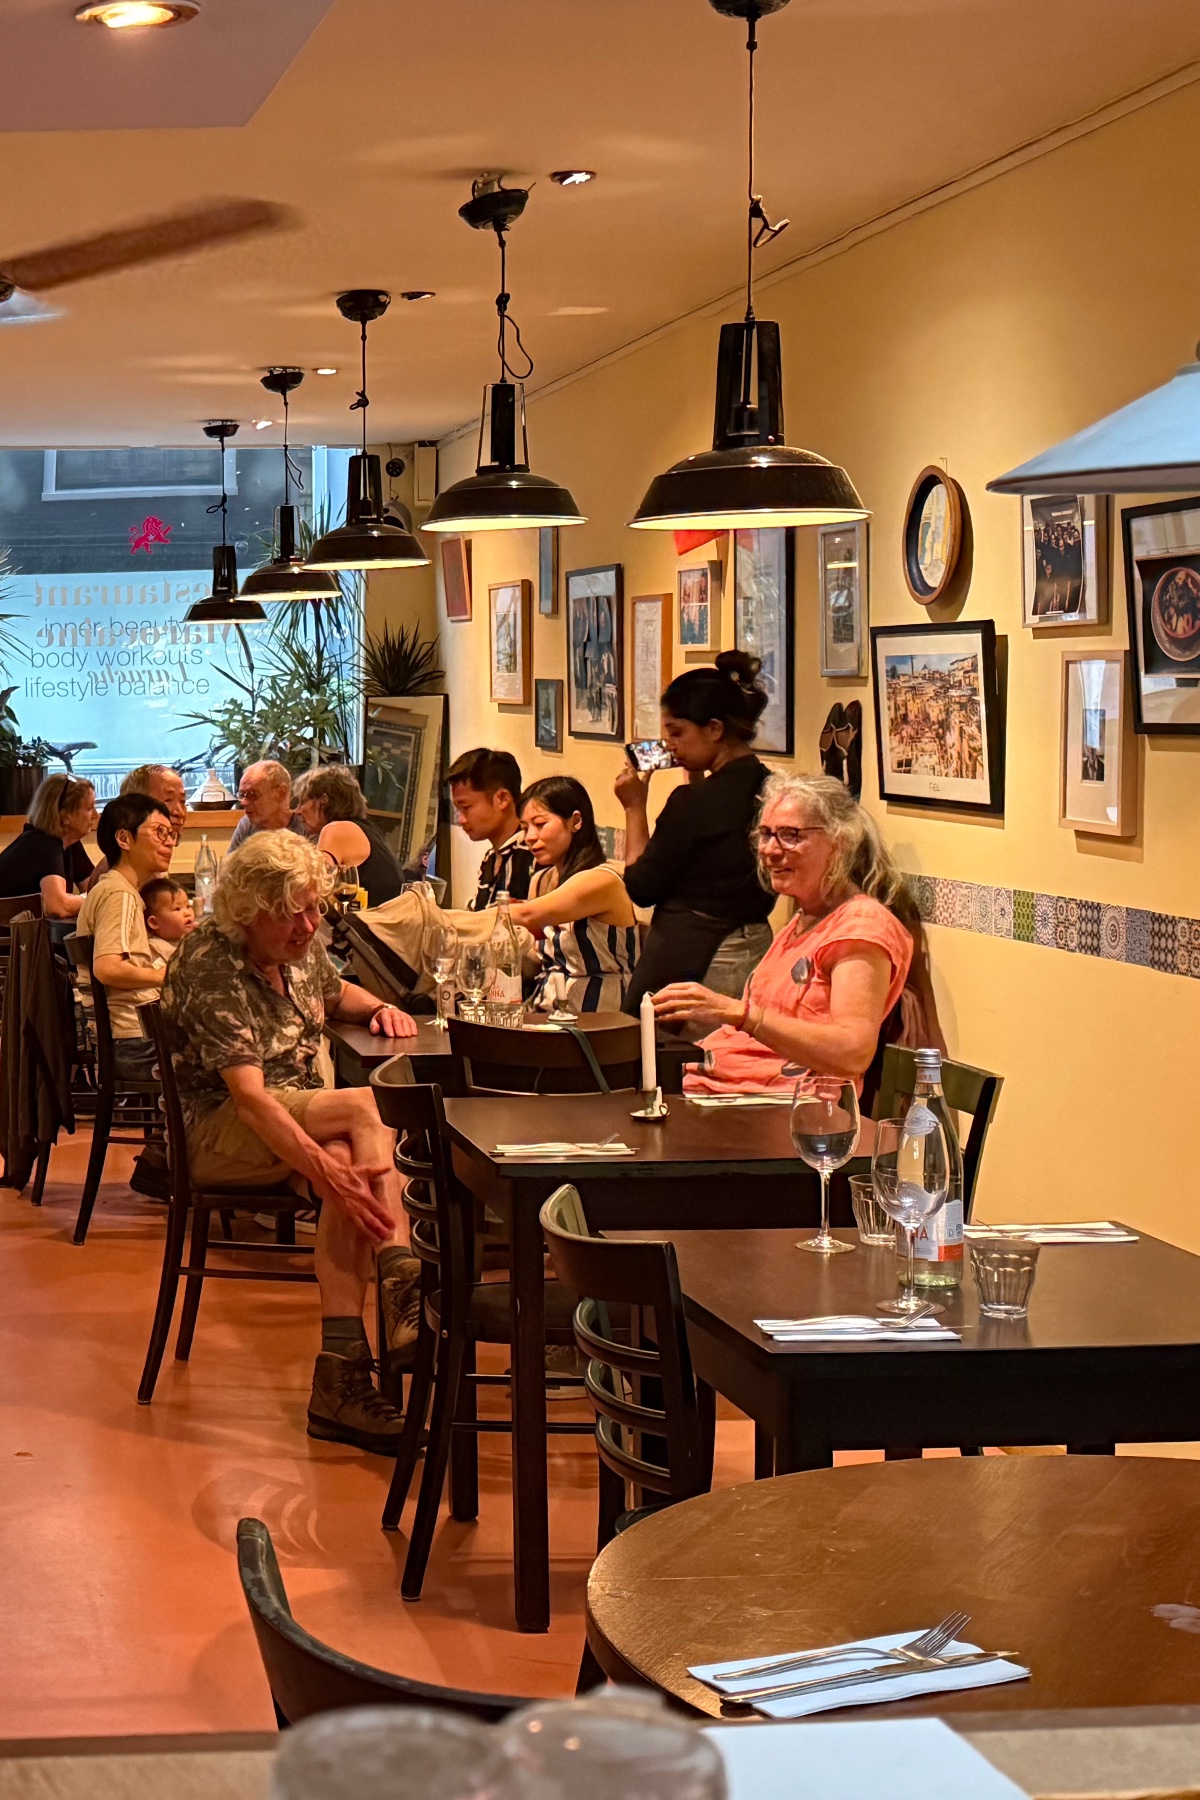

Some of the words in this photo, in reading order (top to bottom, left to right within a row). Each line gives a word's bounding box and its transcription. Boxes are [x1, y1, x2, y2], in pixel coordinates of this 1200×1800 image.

[44, 617, 102, 637] inner
[109, 616, 187, 640] beauty
[31, 647, 89, 672] body
[96, 645, 204, 667] workouts
[24, 676, 109, 701] lifestyle
[118, 676, 211, 697] balance
